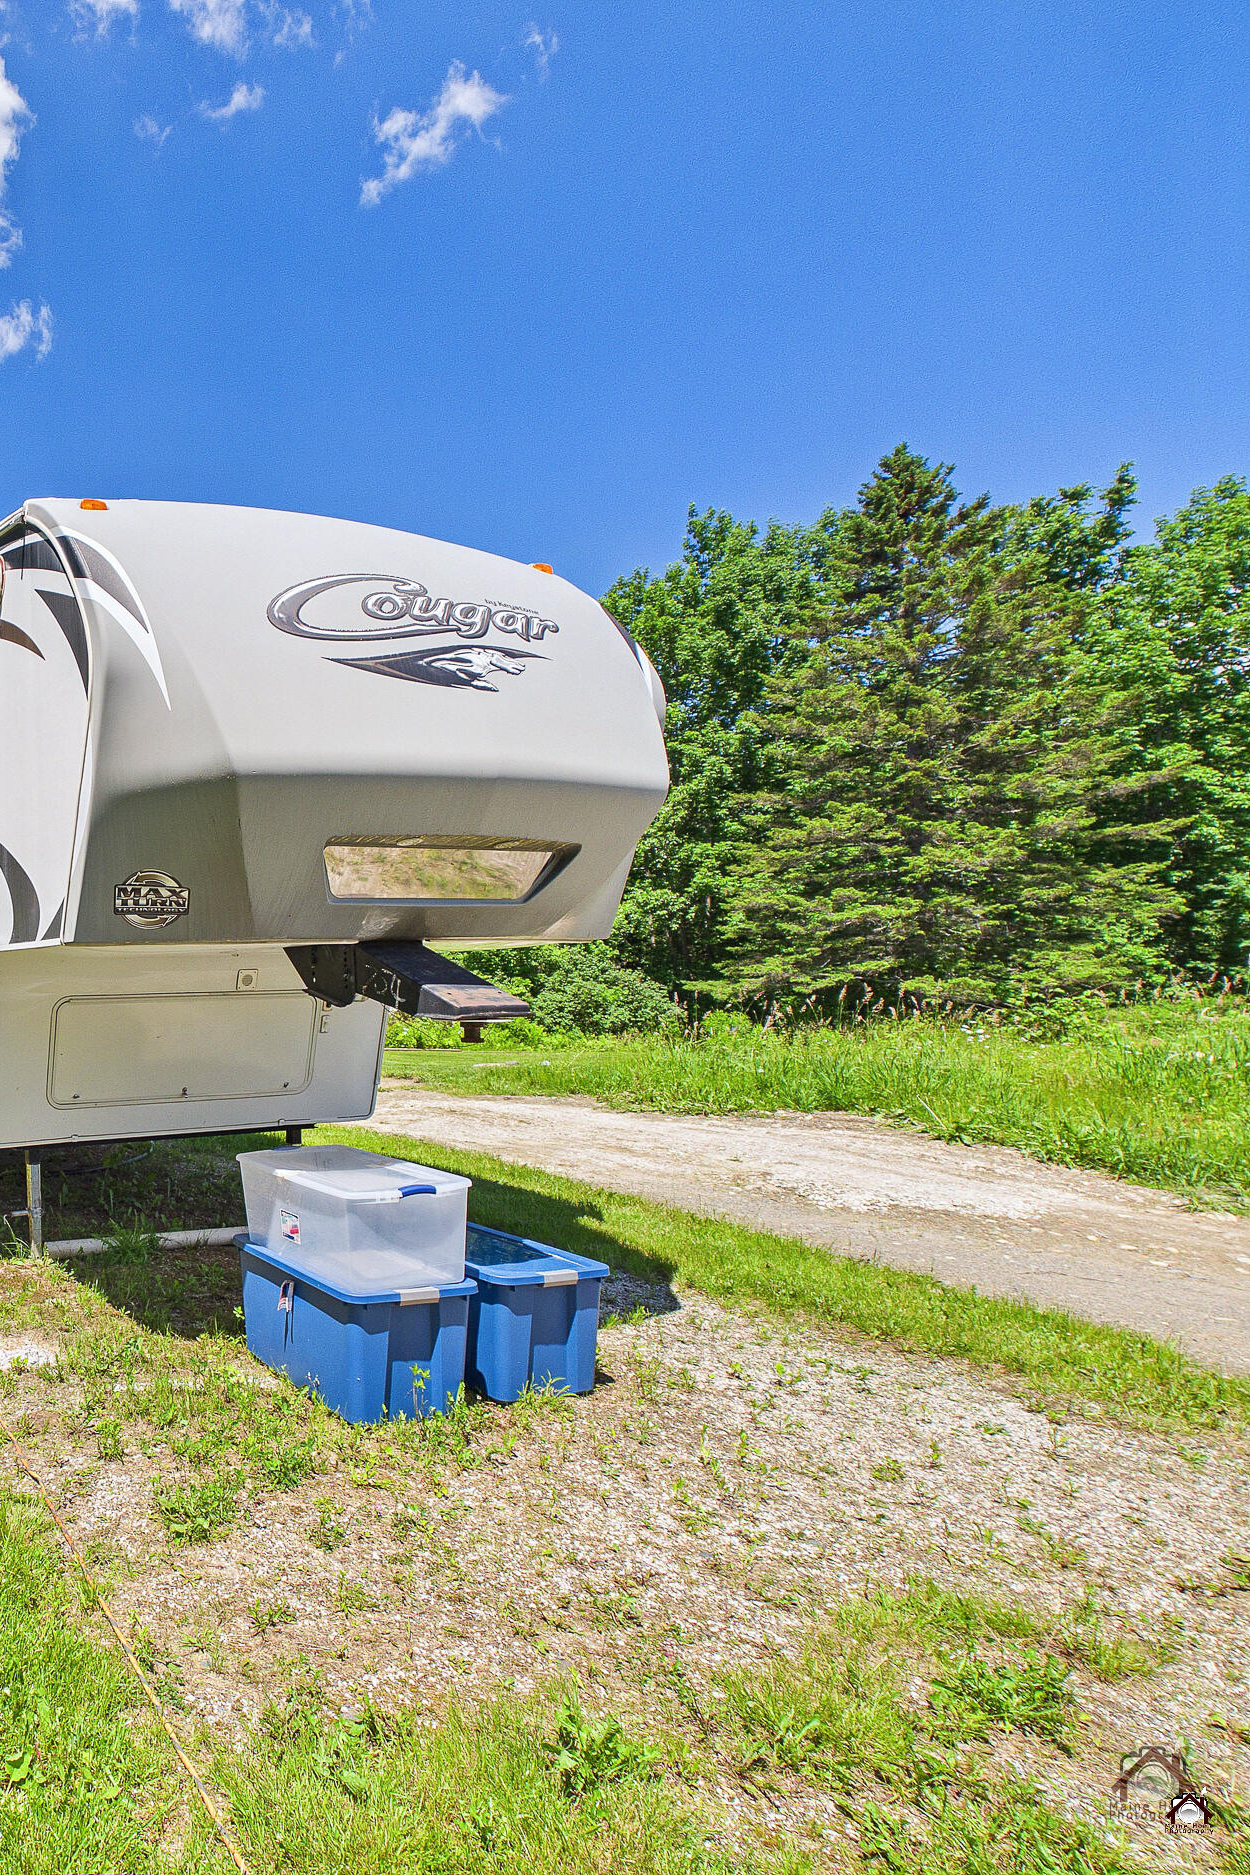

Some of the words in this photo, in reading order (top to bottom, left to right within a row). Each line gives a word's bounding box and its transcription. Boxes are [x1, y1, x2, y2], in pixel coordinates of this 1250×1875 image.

[267, 573, 559, 642] Cougar
[117, 887, 188, 900] MAX
[116, 898, 187, 908] TURN
